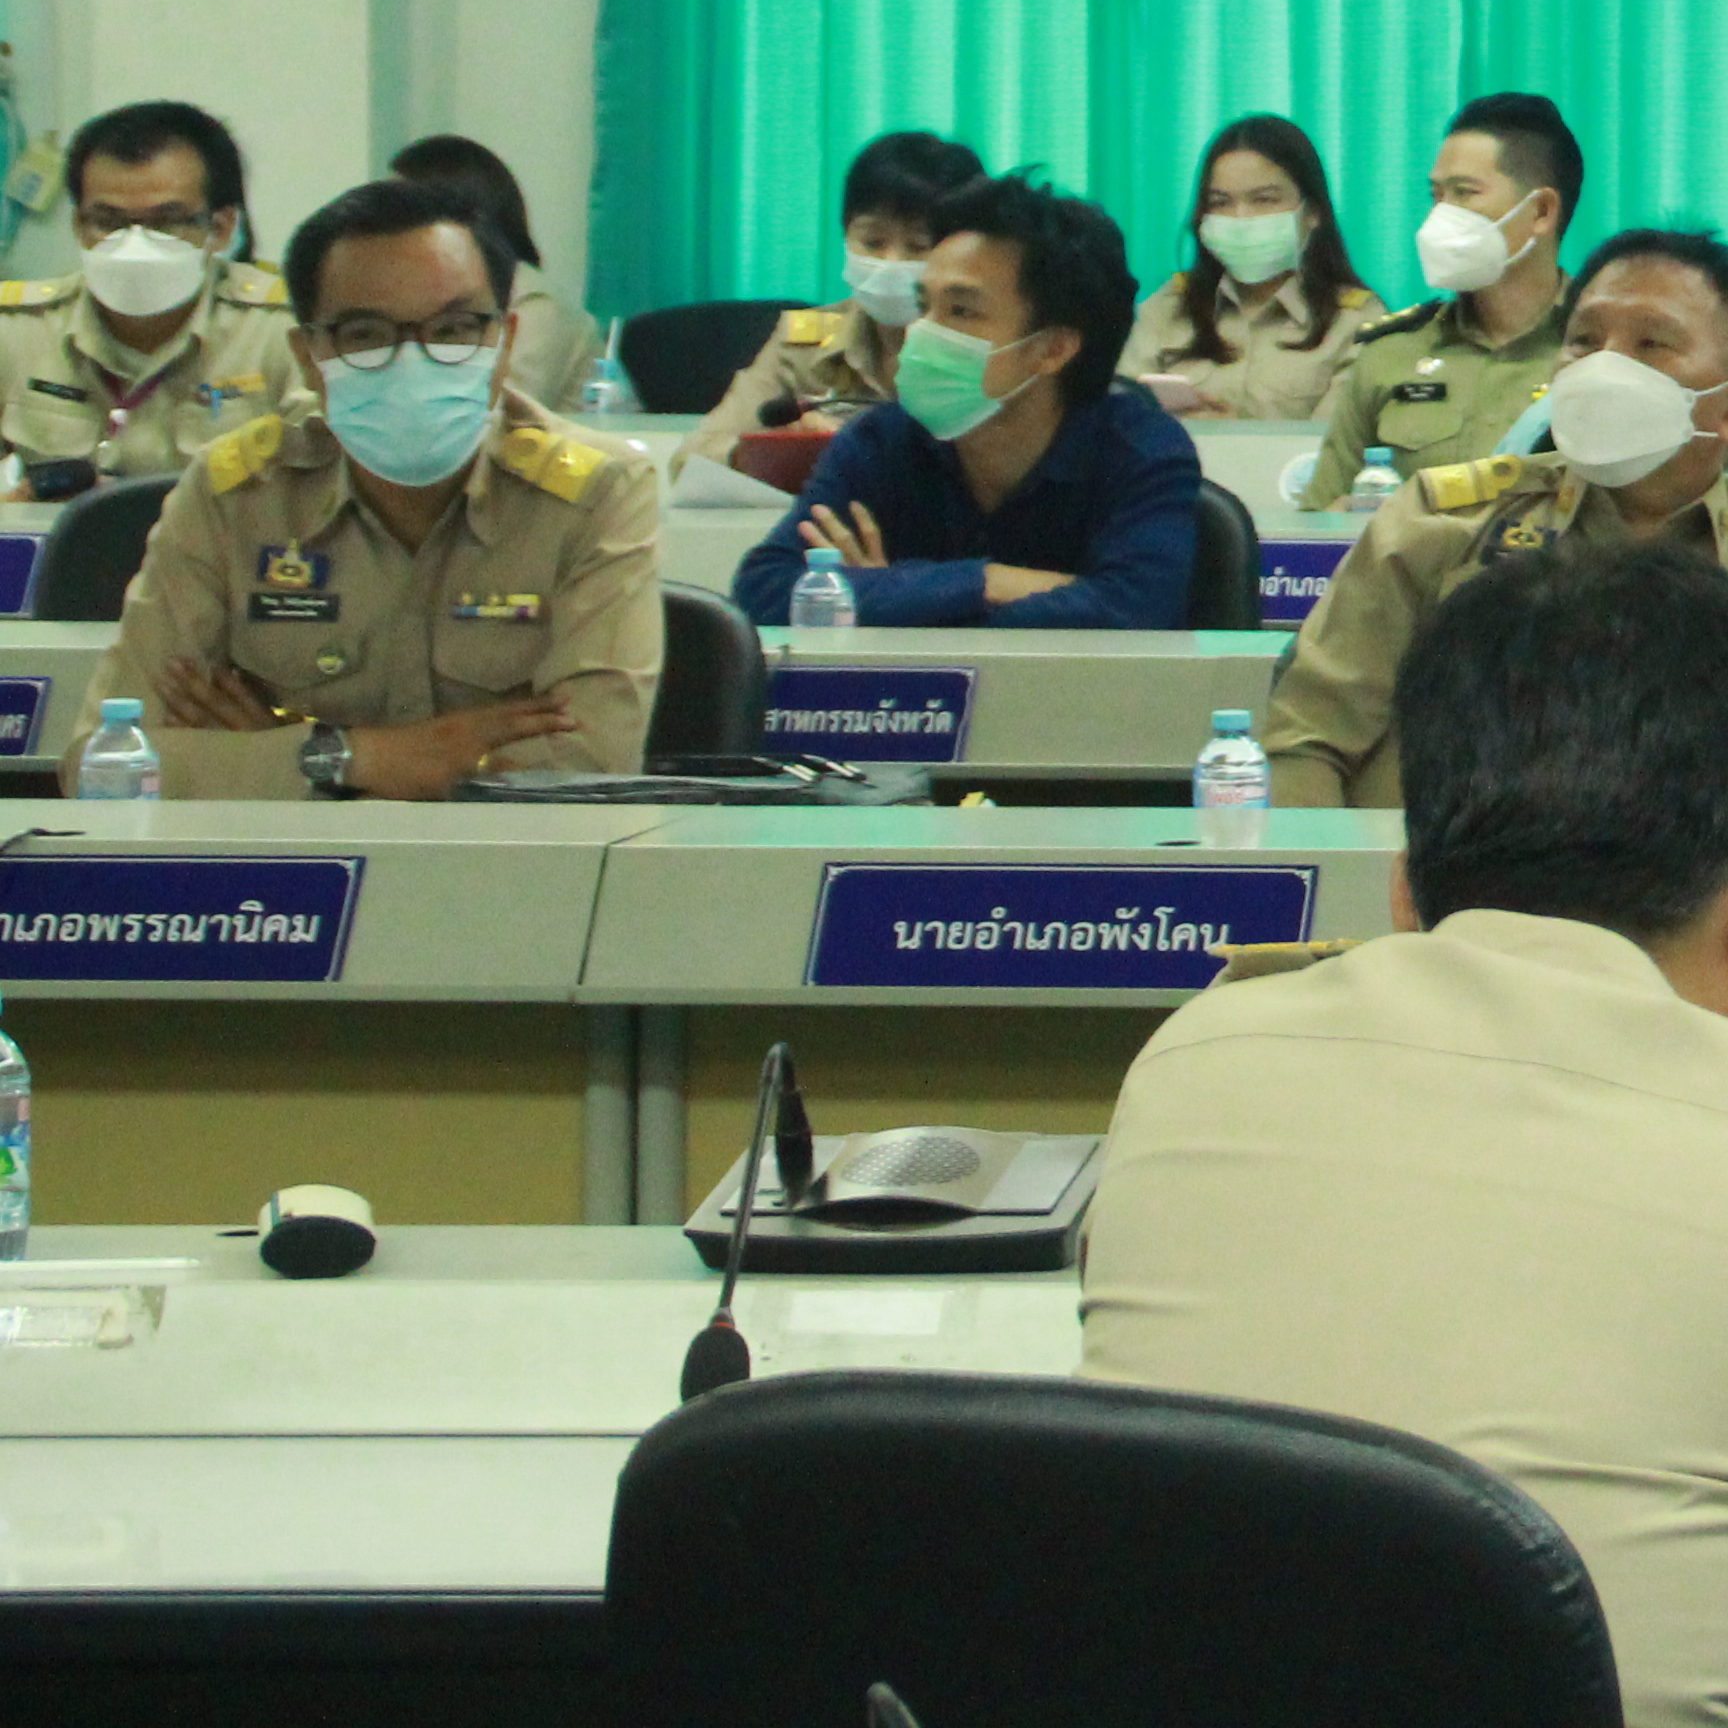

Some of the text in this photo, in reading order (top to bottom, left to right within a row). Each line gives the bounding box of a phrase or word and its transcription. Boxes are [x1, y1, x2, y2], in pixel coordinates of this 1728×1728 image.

[1259, 566, 1329, 597] อำเภอ
[893, 906, 1230, 952] นายอำเภอพังโคน
